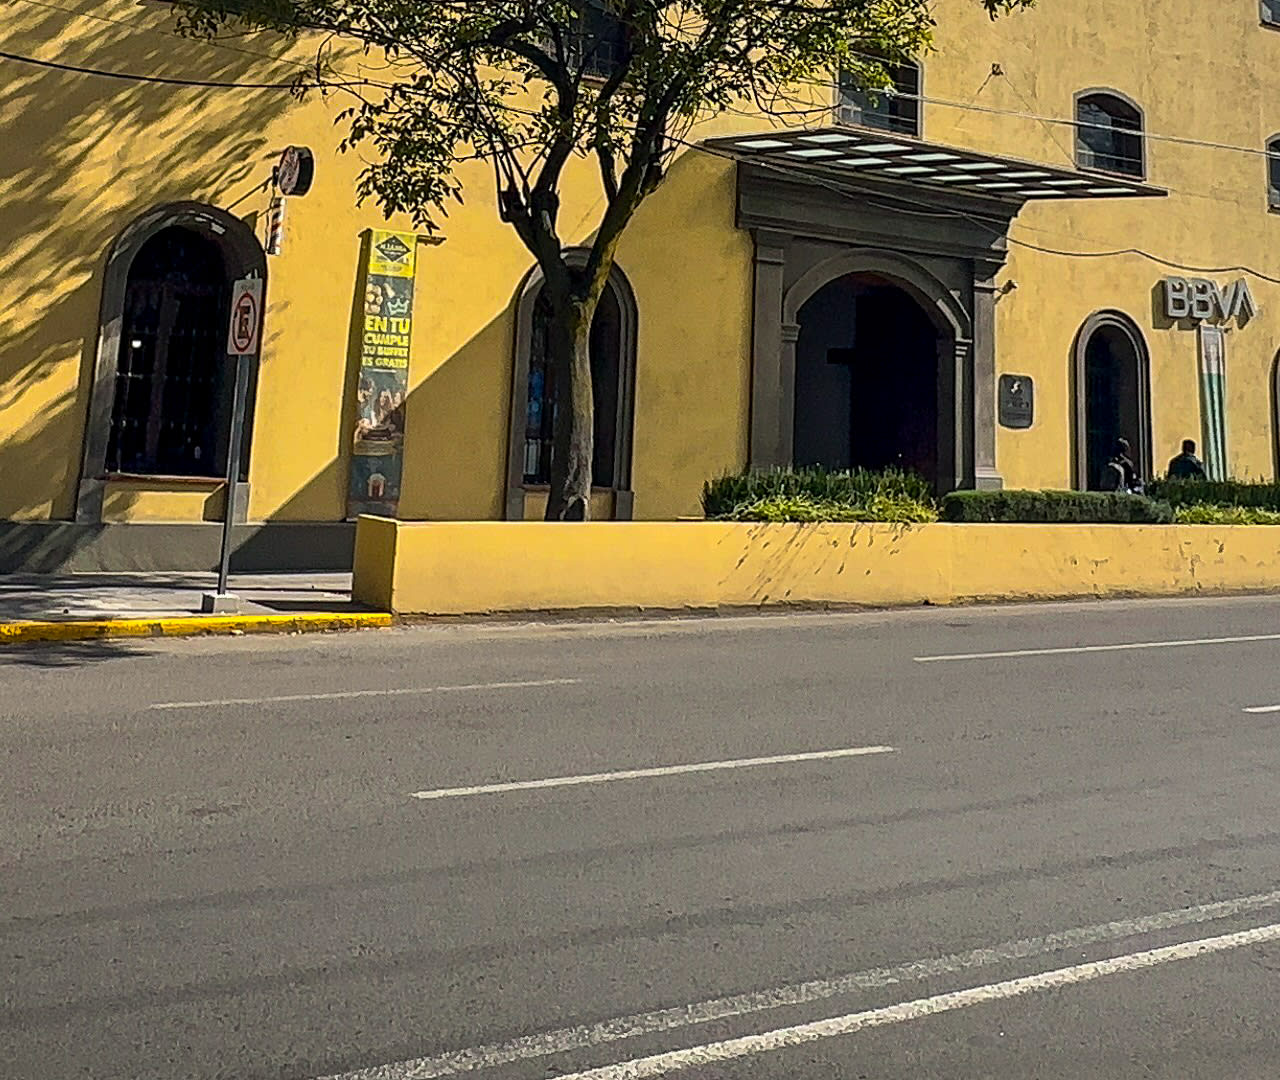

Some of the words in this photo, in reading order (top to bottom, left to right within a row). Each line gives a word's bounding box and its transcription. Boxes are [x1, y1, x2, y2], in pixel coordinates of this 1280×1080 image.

[1165, 275, 1259, 319] BBVA
[365, 315, 388, 332] EN
[390, 316, 410, 334] TU
[364, 332, 409, 347] CUMPLE
